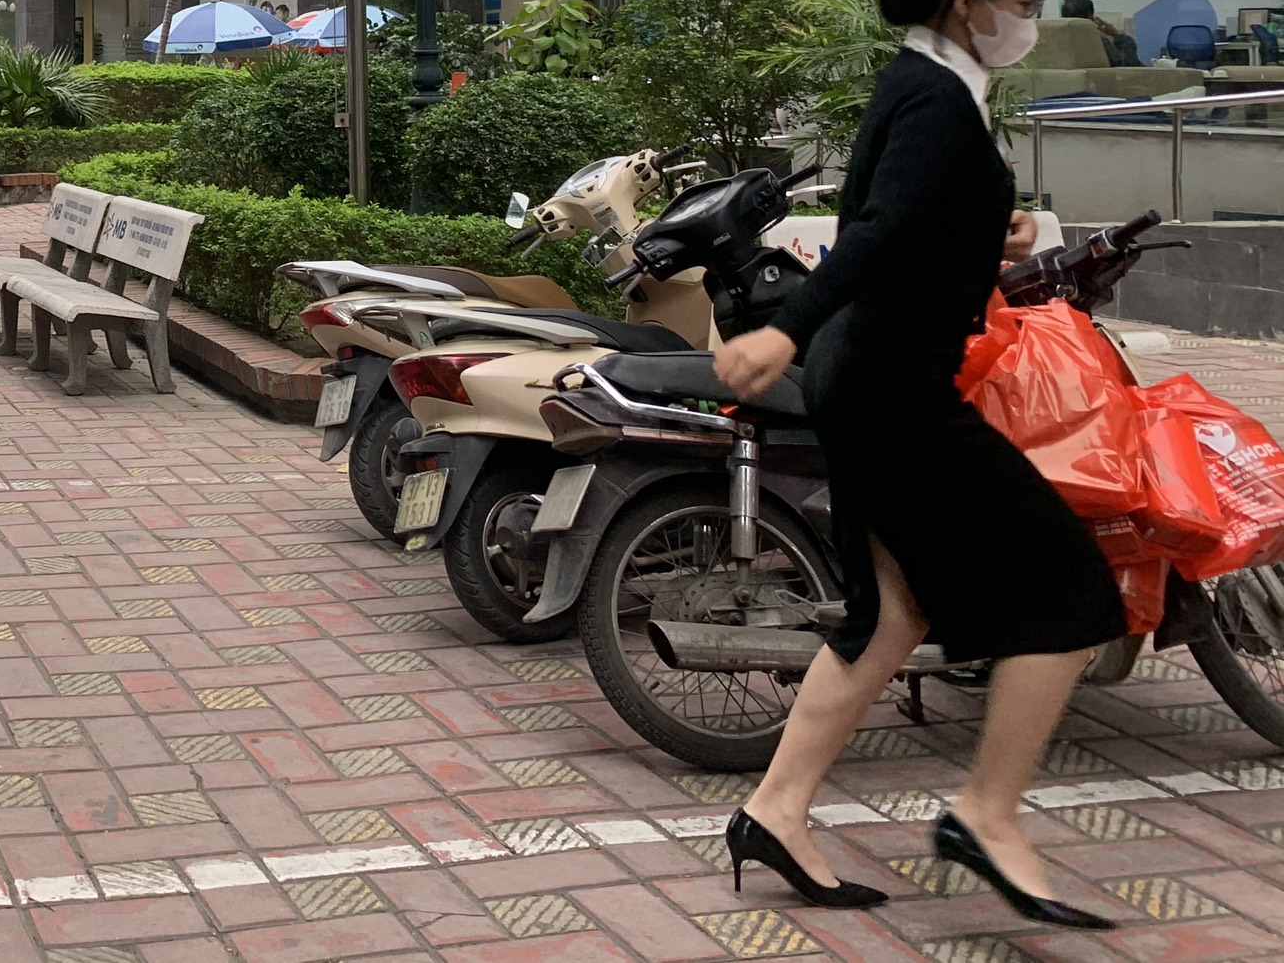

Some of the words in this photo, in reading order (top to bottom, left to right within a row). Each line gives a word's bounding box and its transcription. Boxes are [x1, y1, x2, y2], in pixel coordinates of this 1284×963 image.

[219, 31, 256, 39] VietinBank
[112, 219, 128, 240] MB
[406, 474, 440, 501] 37-V3
